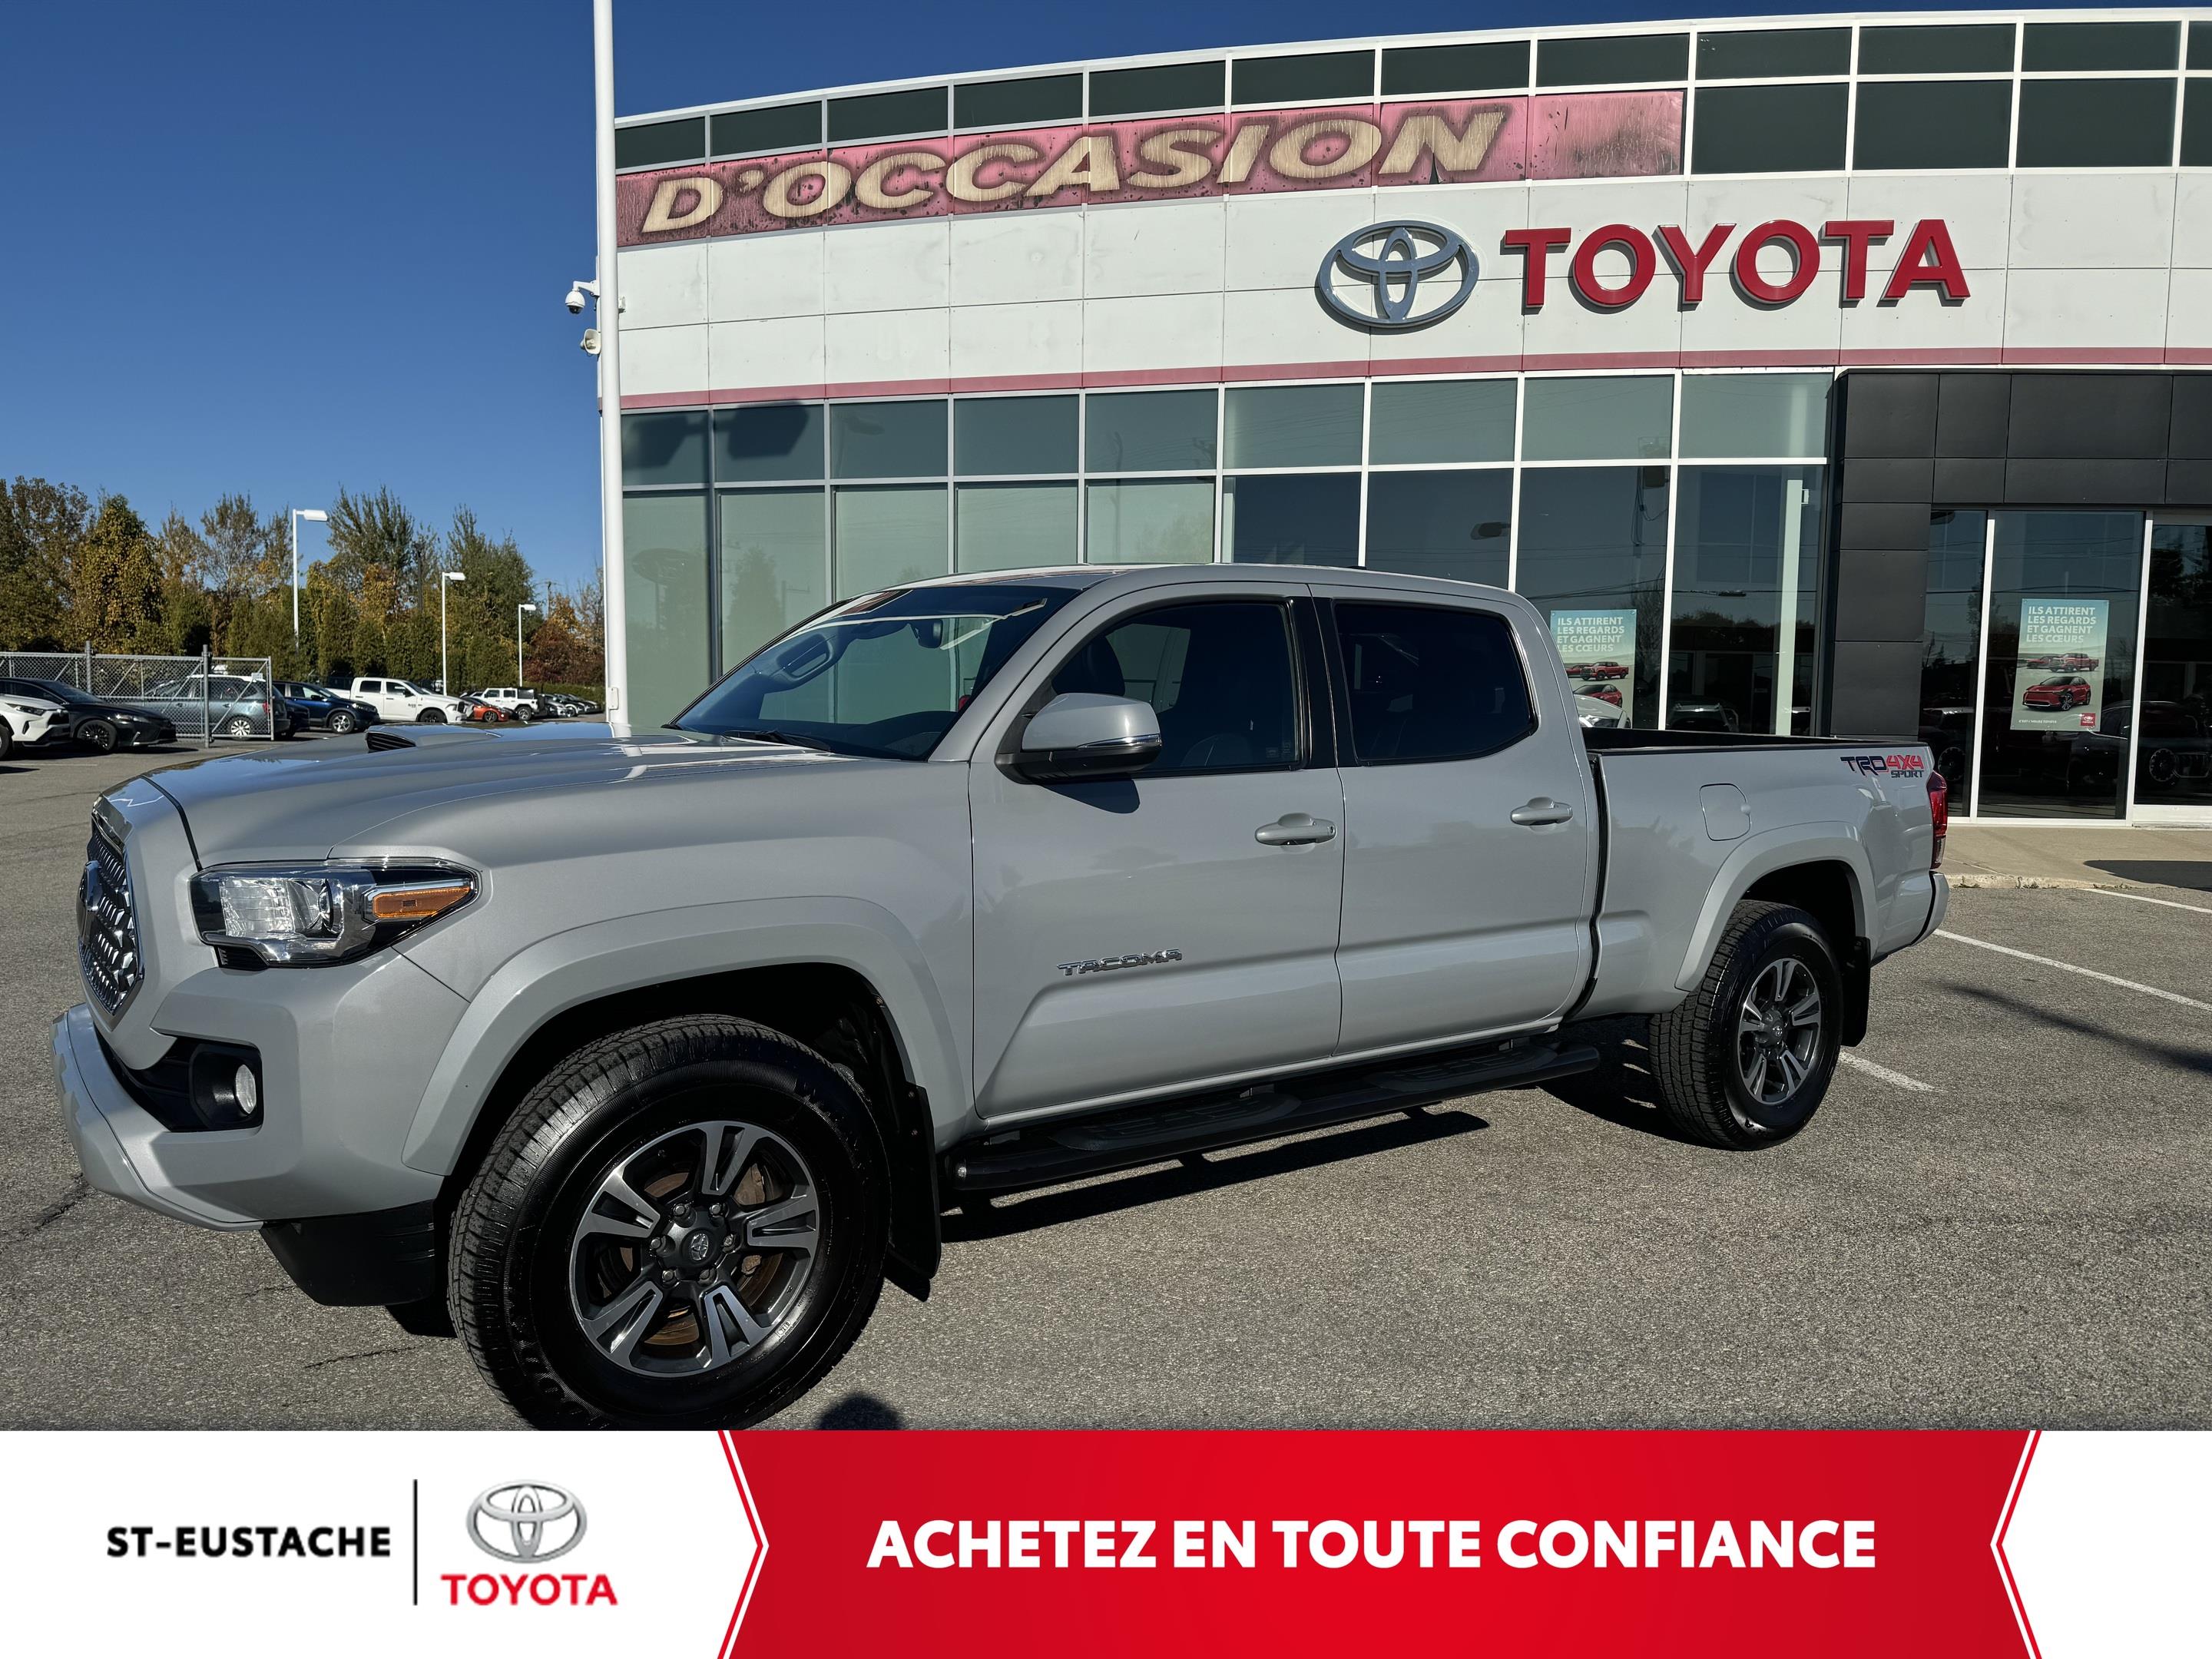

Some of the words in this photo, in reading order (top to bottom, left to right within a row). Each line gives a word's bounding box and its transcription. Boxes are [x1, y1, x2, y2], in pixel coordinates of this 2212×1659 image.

[641, 111, 1508, 233] D'OCCASION
[1504, 220, 1970, 307] TOYOTA
[2028, 606, 2045, 614] ILS
[2045, 606, 2096, 615] ATTIRENT
[1574, 617, 1624, 625] ATTIRENT
[2028, 615, 2045, 624] LES
[2047, 616, 2097, 625] REGARDS
[1576, 626, 1625, 634] REGARDS
[2027, 625, 2039, 634] ET
[2041, 625, 2093, 634] GAGNENT
[1557, 635, 1569, 644] ET
[1570, 635, 1622, 644] GAGNENT
[2026, 634, 2045, 643] LES
[2045, 634, 2084, 643] CŒURS
[1840, 756, 1889, 777] TRD
[1886, 754, 1924, 770] 4X4
[1891, 770, 1924, 778] SPORT
[1057, 949, 1182, 975] TACOMA
